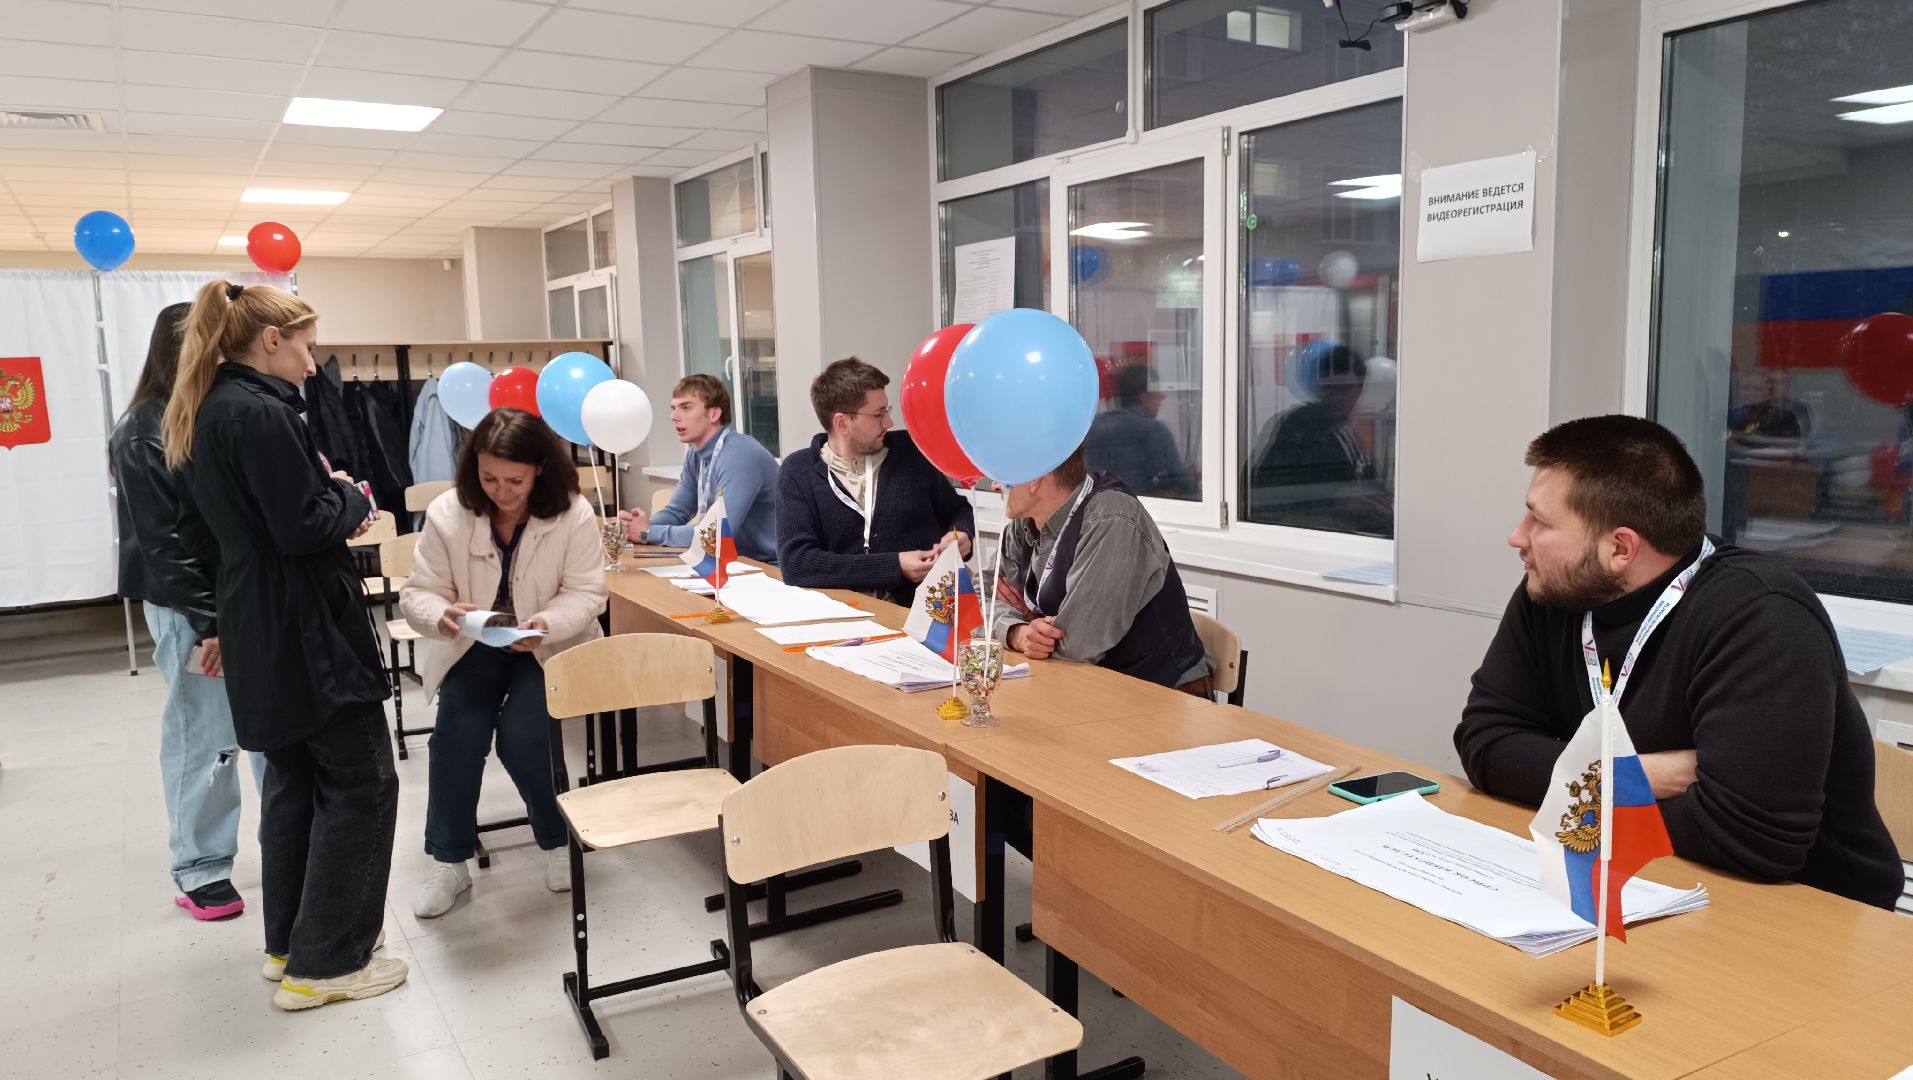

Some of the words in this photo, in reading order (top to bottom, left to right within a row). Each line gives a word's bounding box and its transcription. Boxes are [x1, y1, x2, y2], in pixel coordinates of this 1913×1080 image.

[1428, 189, 1480, 206] ВНИМАНИЕ
[1482, 182, 1524, 198] ВЕДЕТСЯ
[1427, 199, 1524, 222] ВИДЕОРЕГИСТРАЦИЯ
